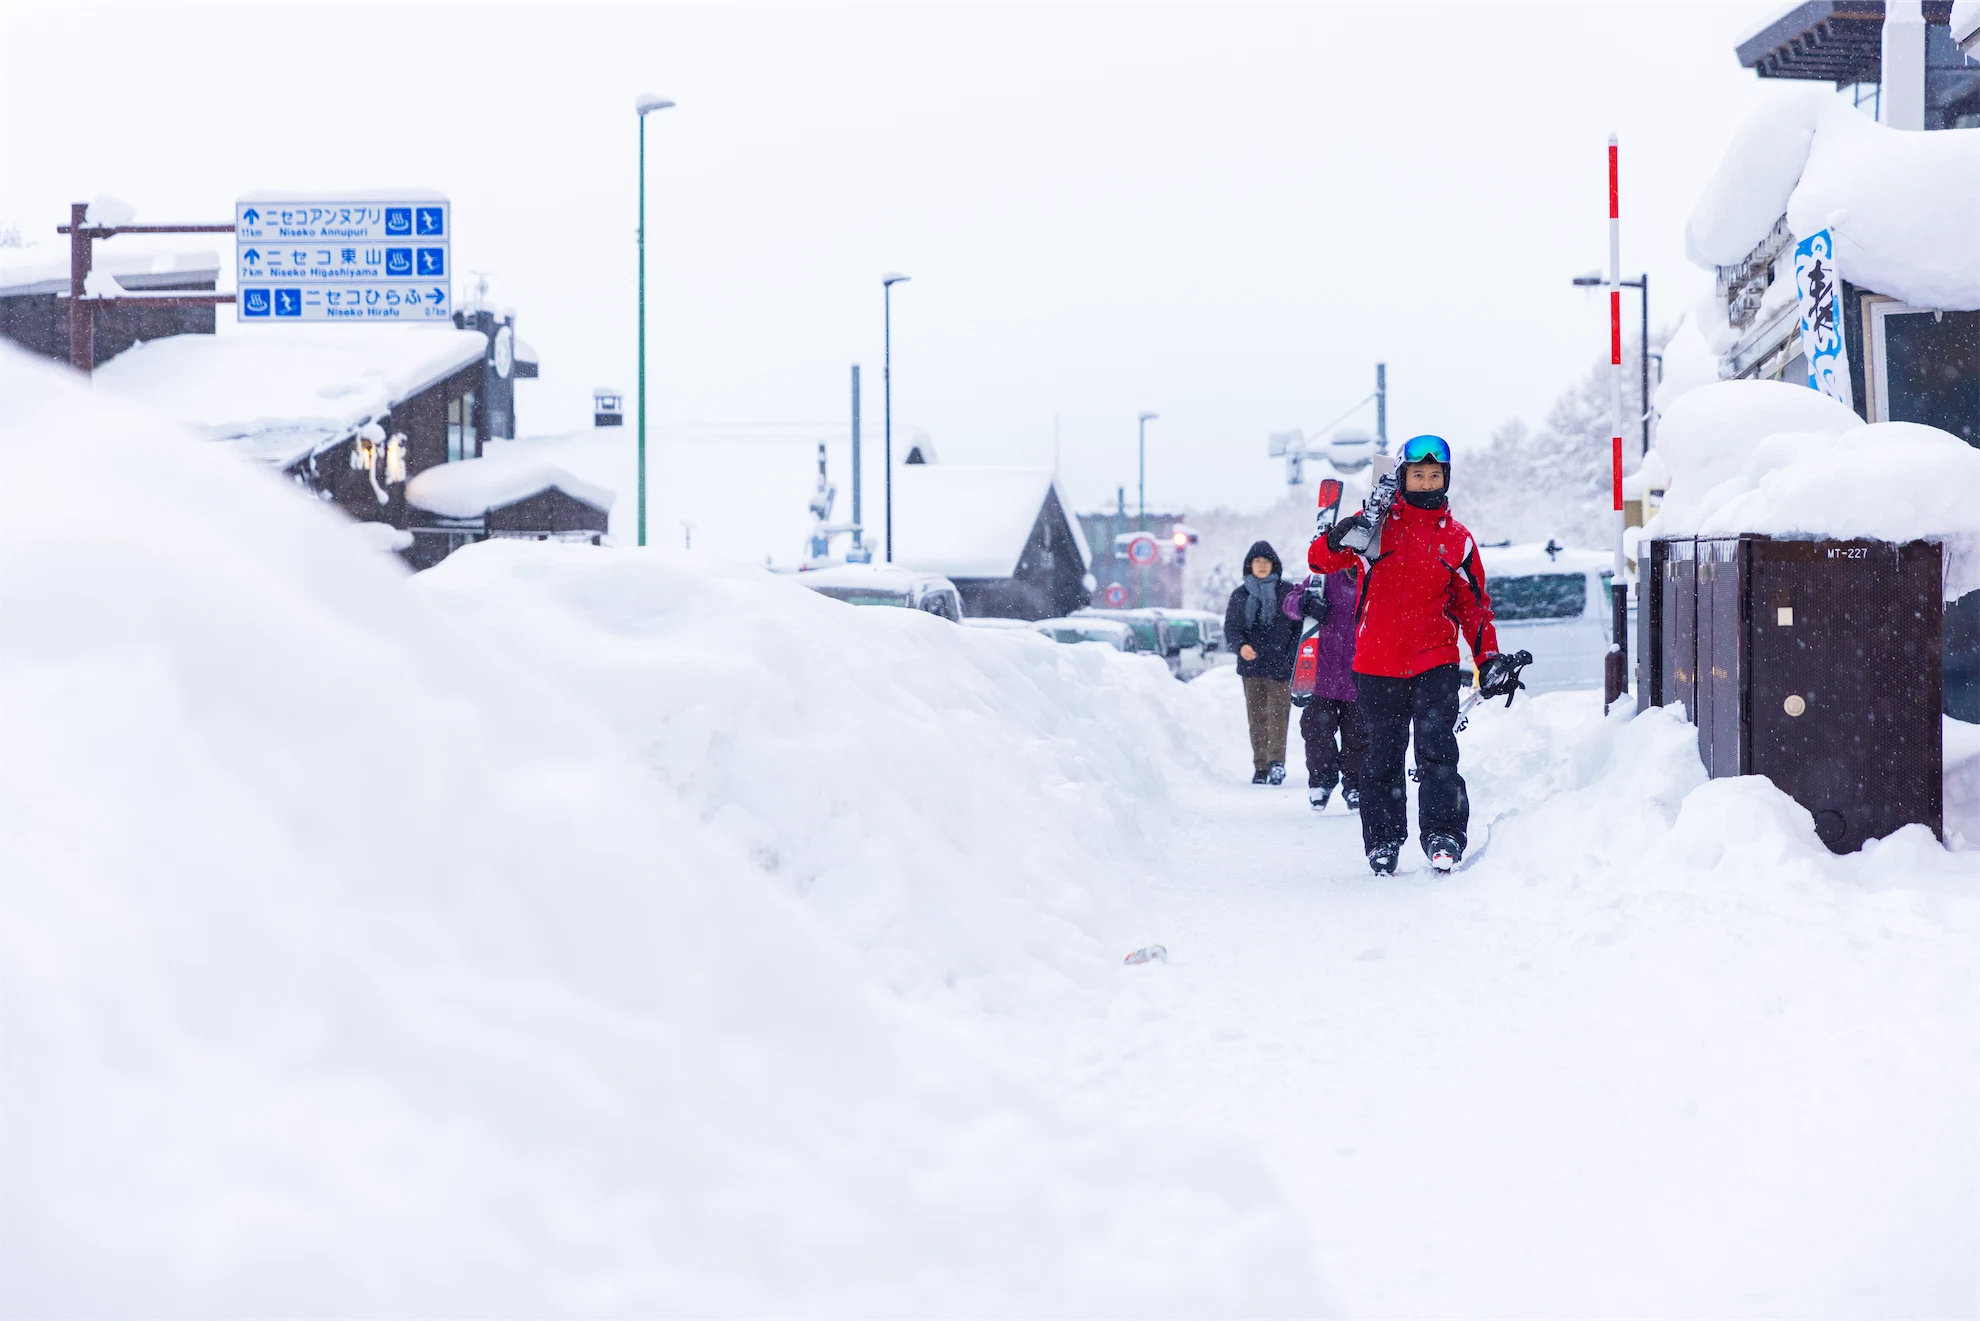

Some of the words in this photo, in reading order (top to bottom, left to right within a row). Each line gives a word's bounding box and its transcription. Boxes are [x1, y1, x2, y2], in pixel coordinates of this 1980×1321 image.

[265, 207, 381, 226] ニセコアンヌプリ
[279, 227, 316, 238] Niseko
[320, 227, 369, 240] Annupuri
[266, 247, 382, 266] ニセコ東山
[269, 267, 307, 278] Niseko
[309, 267, 379, 280] Higashiyama
[305, 288, 422, 306] ニセコひらふ
[326, 306, 364, 318] Niseko
[366, 306, 401, 318] Hirafu
[1827, 548, 1868, 559] MT-227
